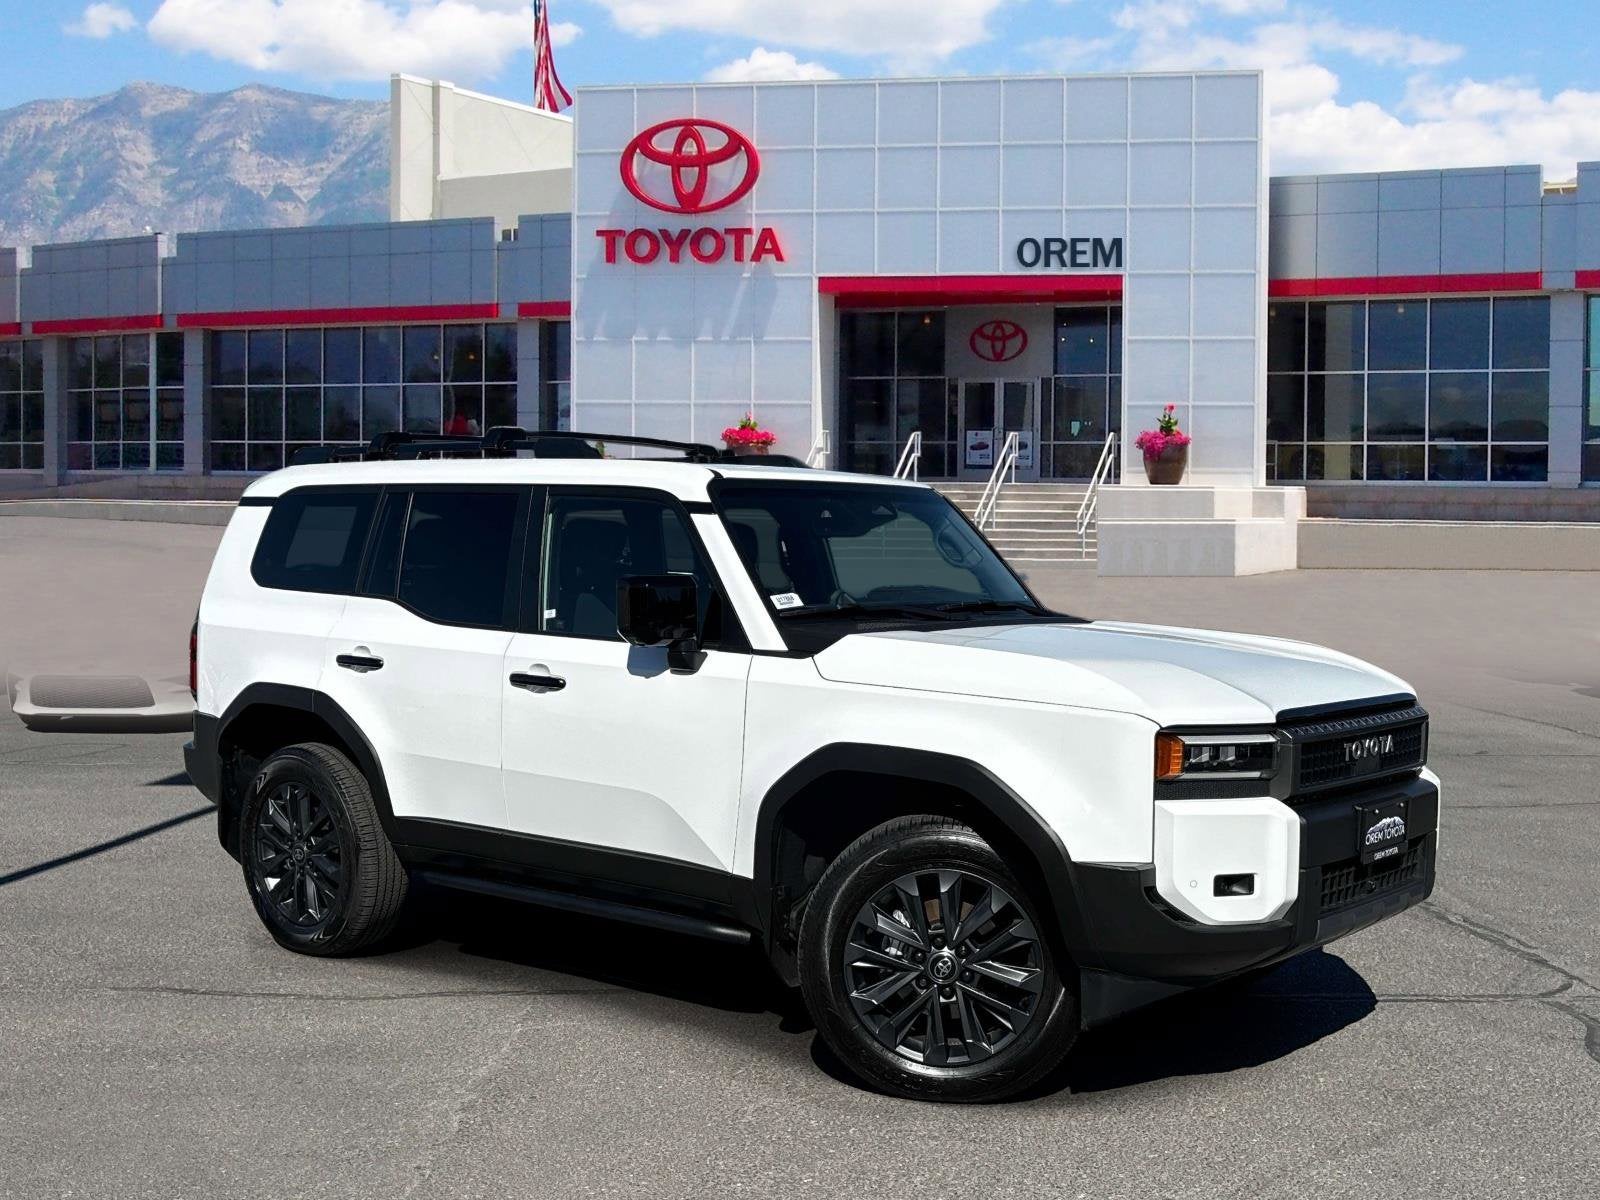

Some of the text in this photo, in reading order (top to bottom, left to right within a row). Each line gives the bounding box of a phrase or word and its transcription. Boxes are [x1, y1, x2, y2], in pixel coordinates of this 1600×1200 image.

[595, 227, 785, 264] TOYOTA
[1016, 237, 1123, 268] OREM
[1343, 734, 1394, 762] TOYOTA
[1365, 824, 1405, 846] OREM TOYOTA
